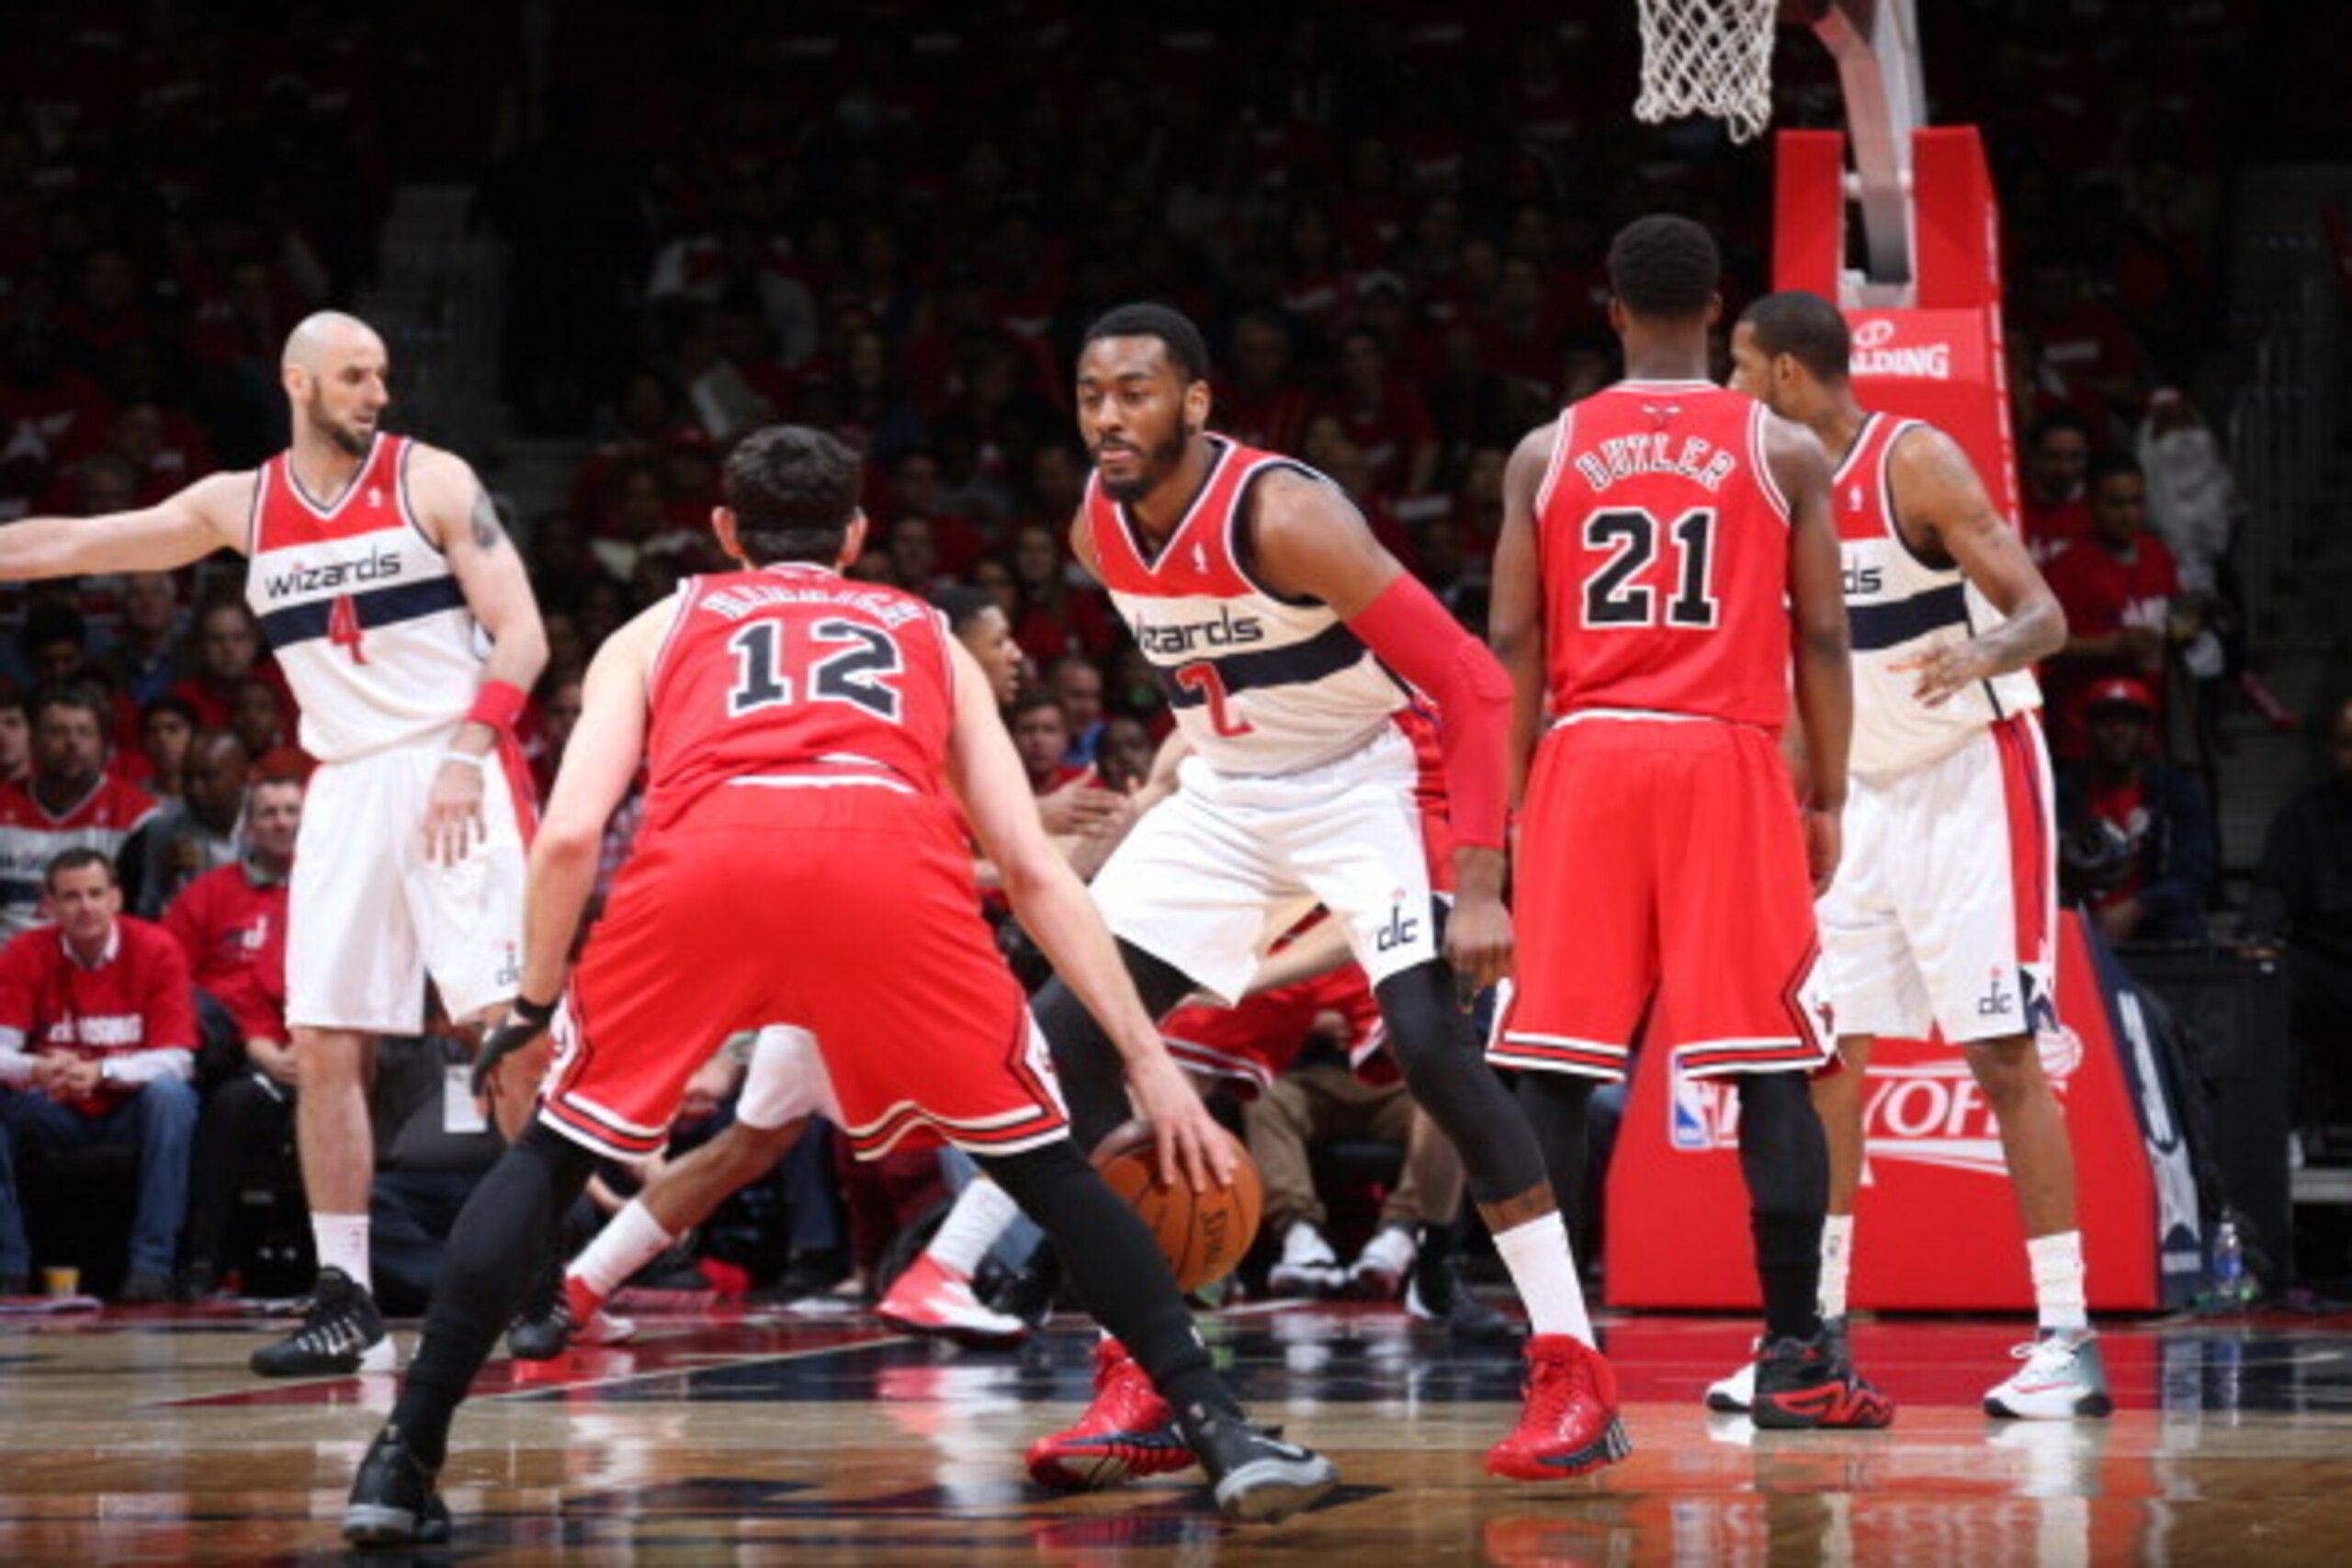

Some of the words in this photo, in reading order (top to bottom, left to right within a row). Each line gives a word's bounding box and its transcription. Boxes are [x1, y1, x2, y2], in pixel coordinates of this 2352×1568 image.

[1575, 432, 1737, 493] BUTLER
[265, 543, 401, 598] wizards
[1581, 506, 1720, 630] 21
[329, 593, 369, 665] 4
[728, 617, 904, 725] 12
[1175, 661, 1255, 738] 2
[1376, 905, 1419, 952] dc
[1977, 980, 2012, 1015] dc
